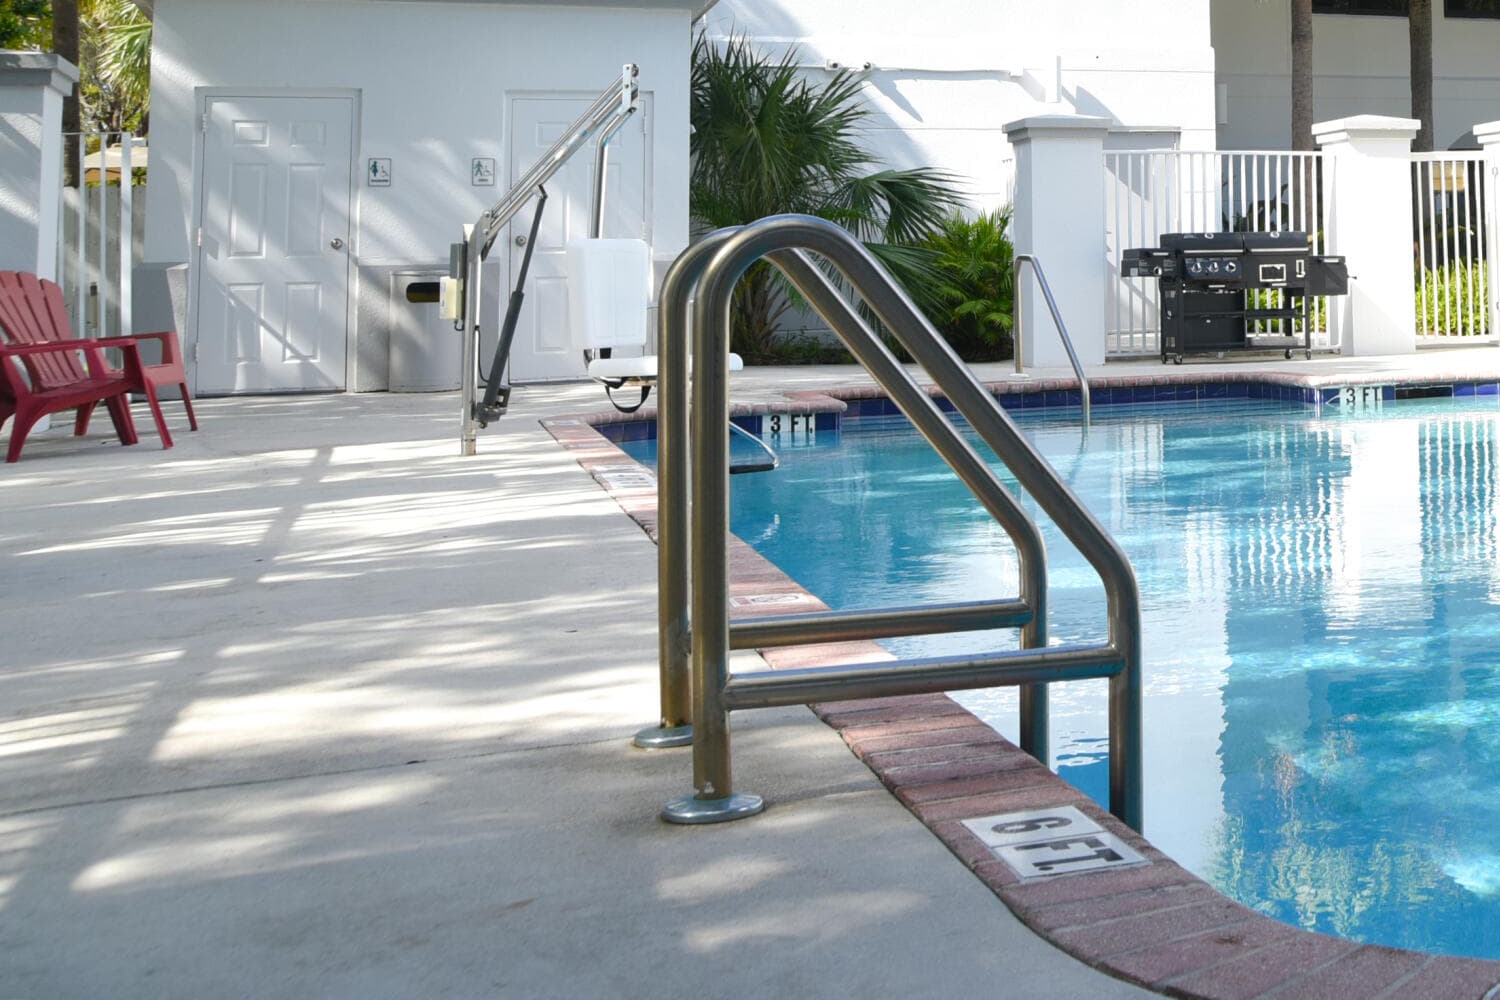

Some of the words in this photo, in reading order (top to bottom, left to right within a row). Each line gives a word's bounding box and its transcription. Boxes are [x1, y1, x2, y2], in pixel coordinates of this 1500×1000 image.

[1346, 387, 1356, 403] 3
[770, 414, 780, 432] 3
[791, 413, 813, 434] FT.
[991, 816, 1072, 834] 6
[1013, 836, 1124, 871] FT.
